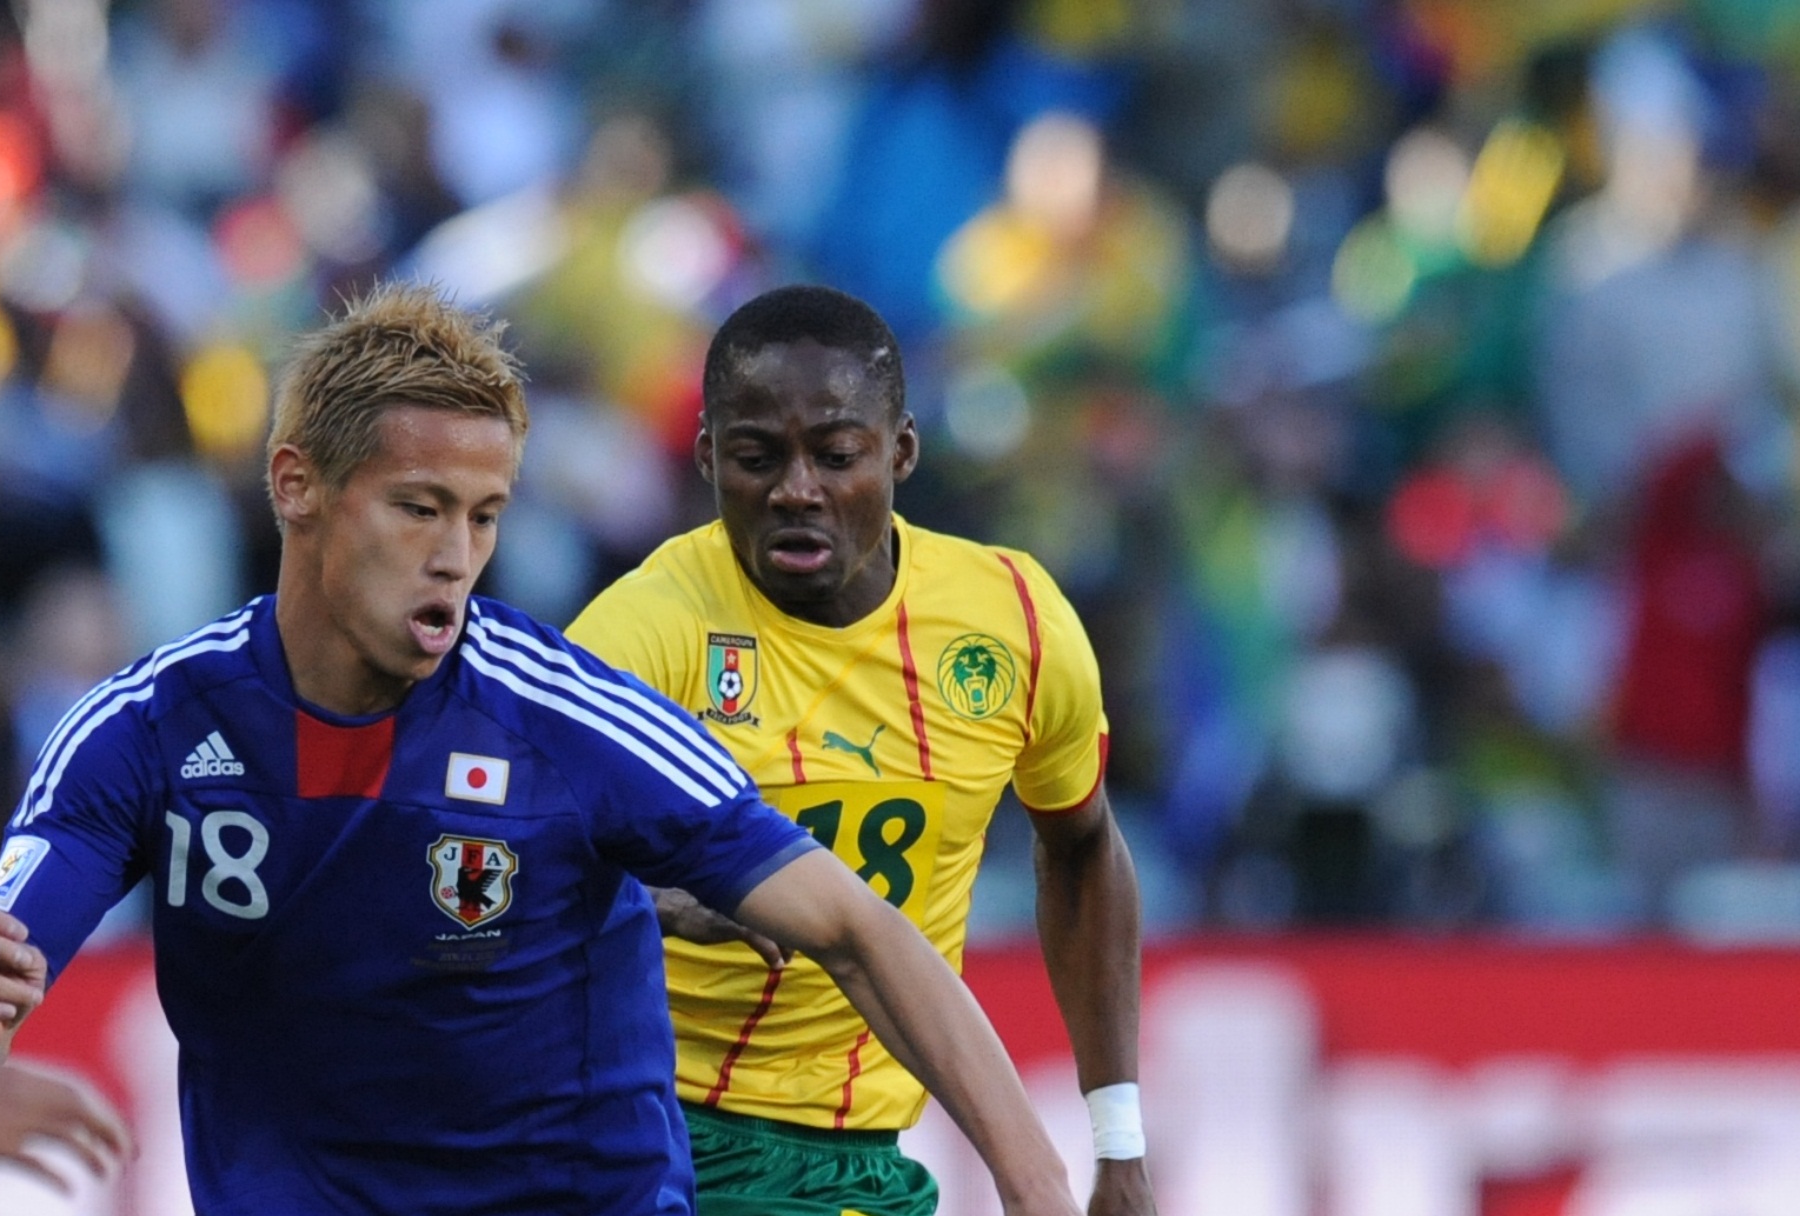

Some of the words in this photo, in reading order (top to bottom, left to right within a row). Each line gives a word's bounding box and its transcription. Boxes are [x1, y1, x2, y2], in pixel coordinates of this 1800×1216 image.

[180, 758, 245, 779] adidas
[165, 809, 270, 920] 18
[443, 846, 502, 867] JFA
